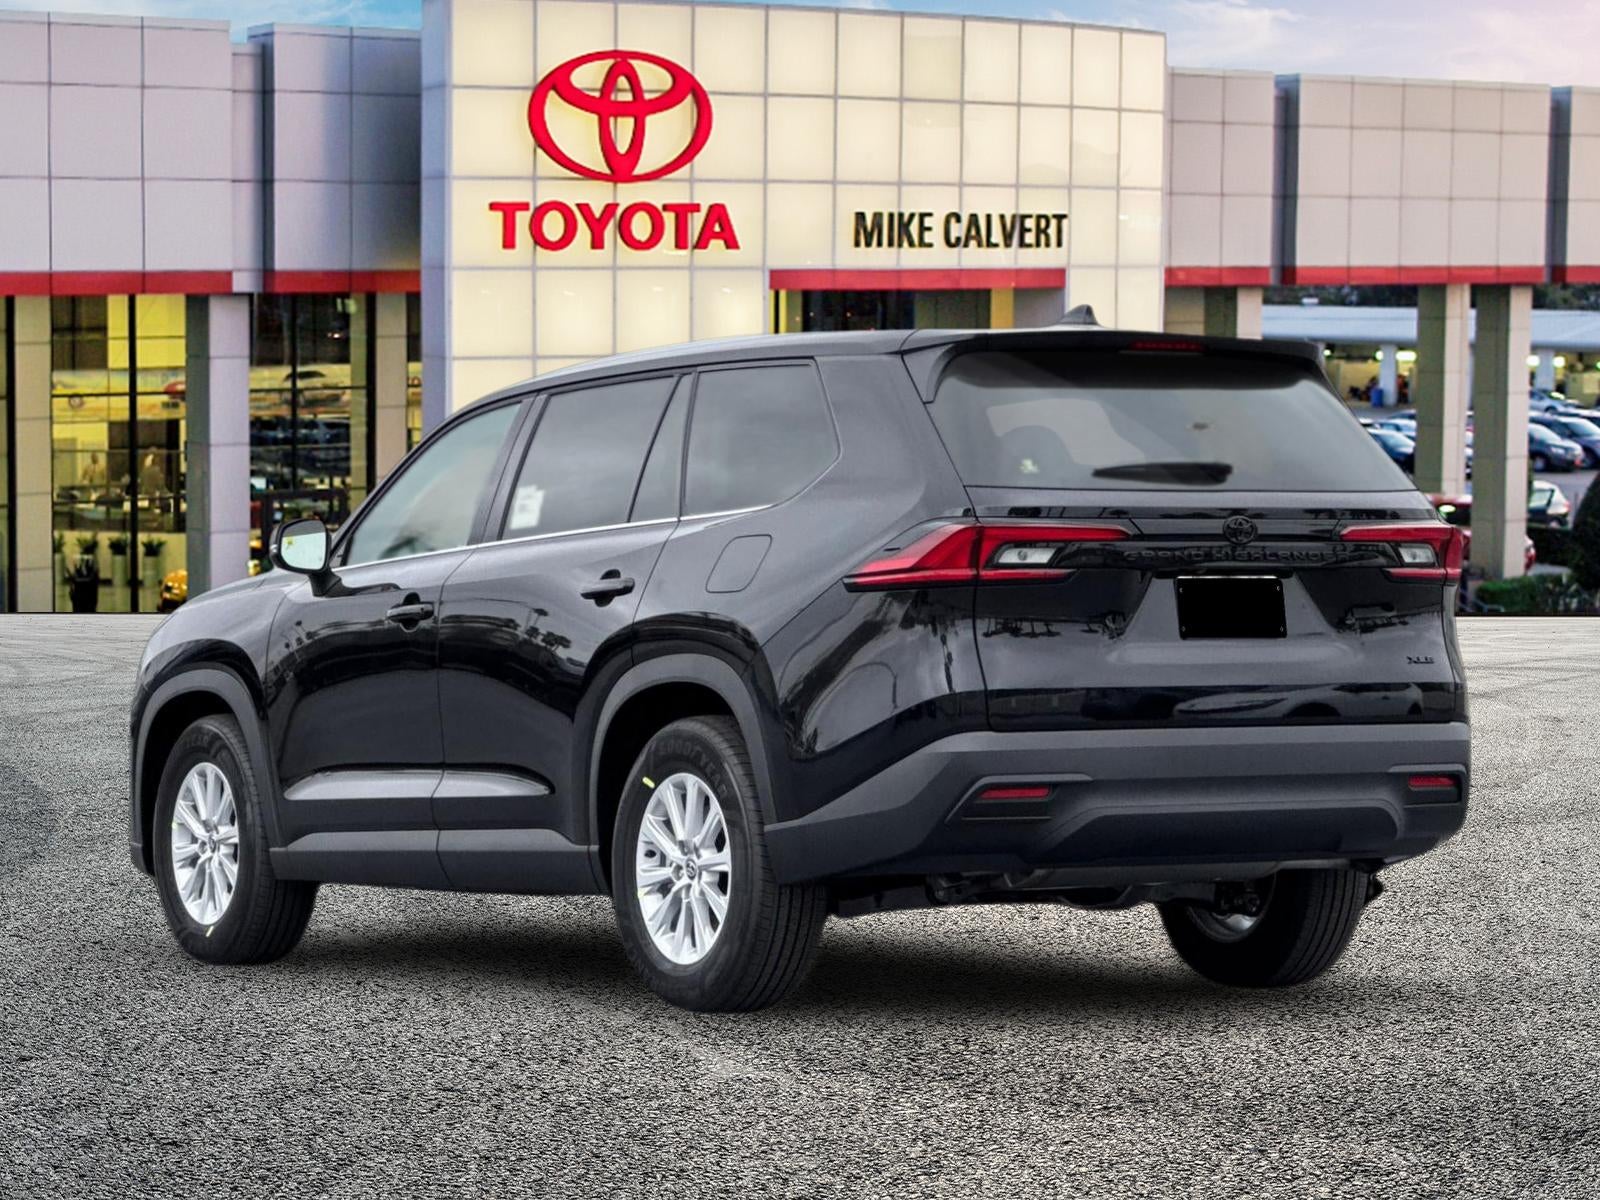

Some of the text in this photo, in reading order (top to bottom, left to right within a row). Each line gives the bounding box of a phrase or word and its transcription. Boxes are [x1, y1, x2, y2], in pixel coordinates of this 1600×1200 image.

[488, 200, 741, 251] TOYOTA
[853, 211, 1068, 249] MIKE CALVERT
[1123, 550, 1351, 561] GRAND HIGHLANDER
